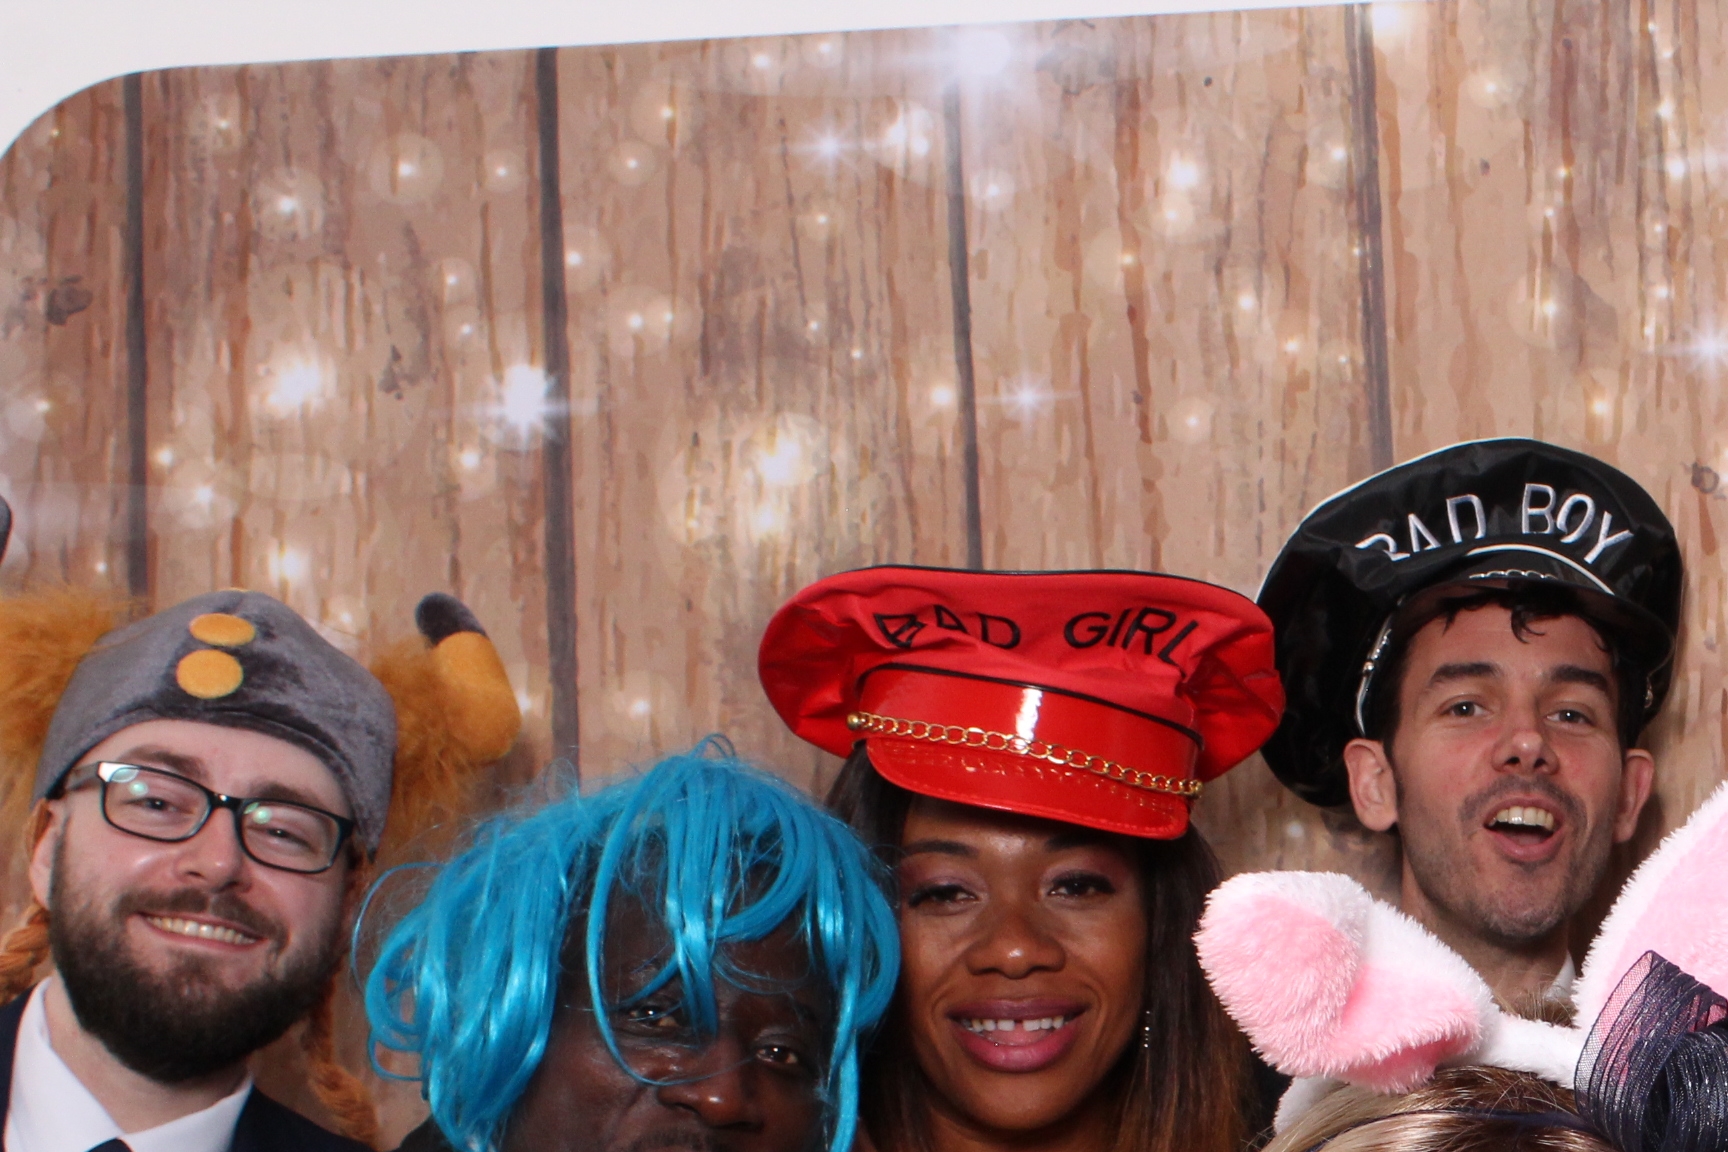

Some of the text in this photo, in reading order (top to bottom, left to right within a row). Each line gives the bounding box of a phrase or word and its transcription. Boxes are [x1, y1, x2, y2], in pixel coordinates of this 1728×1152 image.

[1521, 482, 1634, 565] BOY
[872, 603, 1200, 676] BAD GIRL
